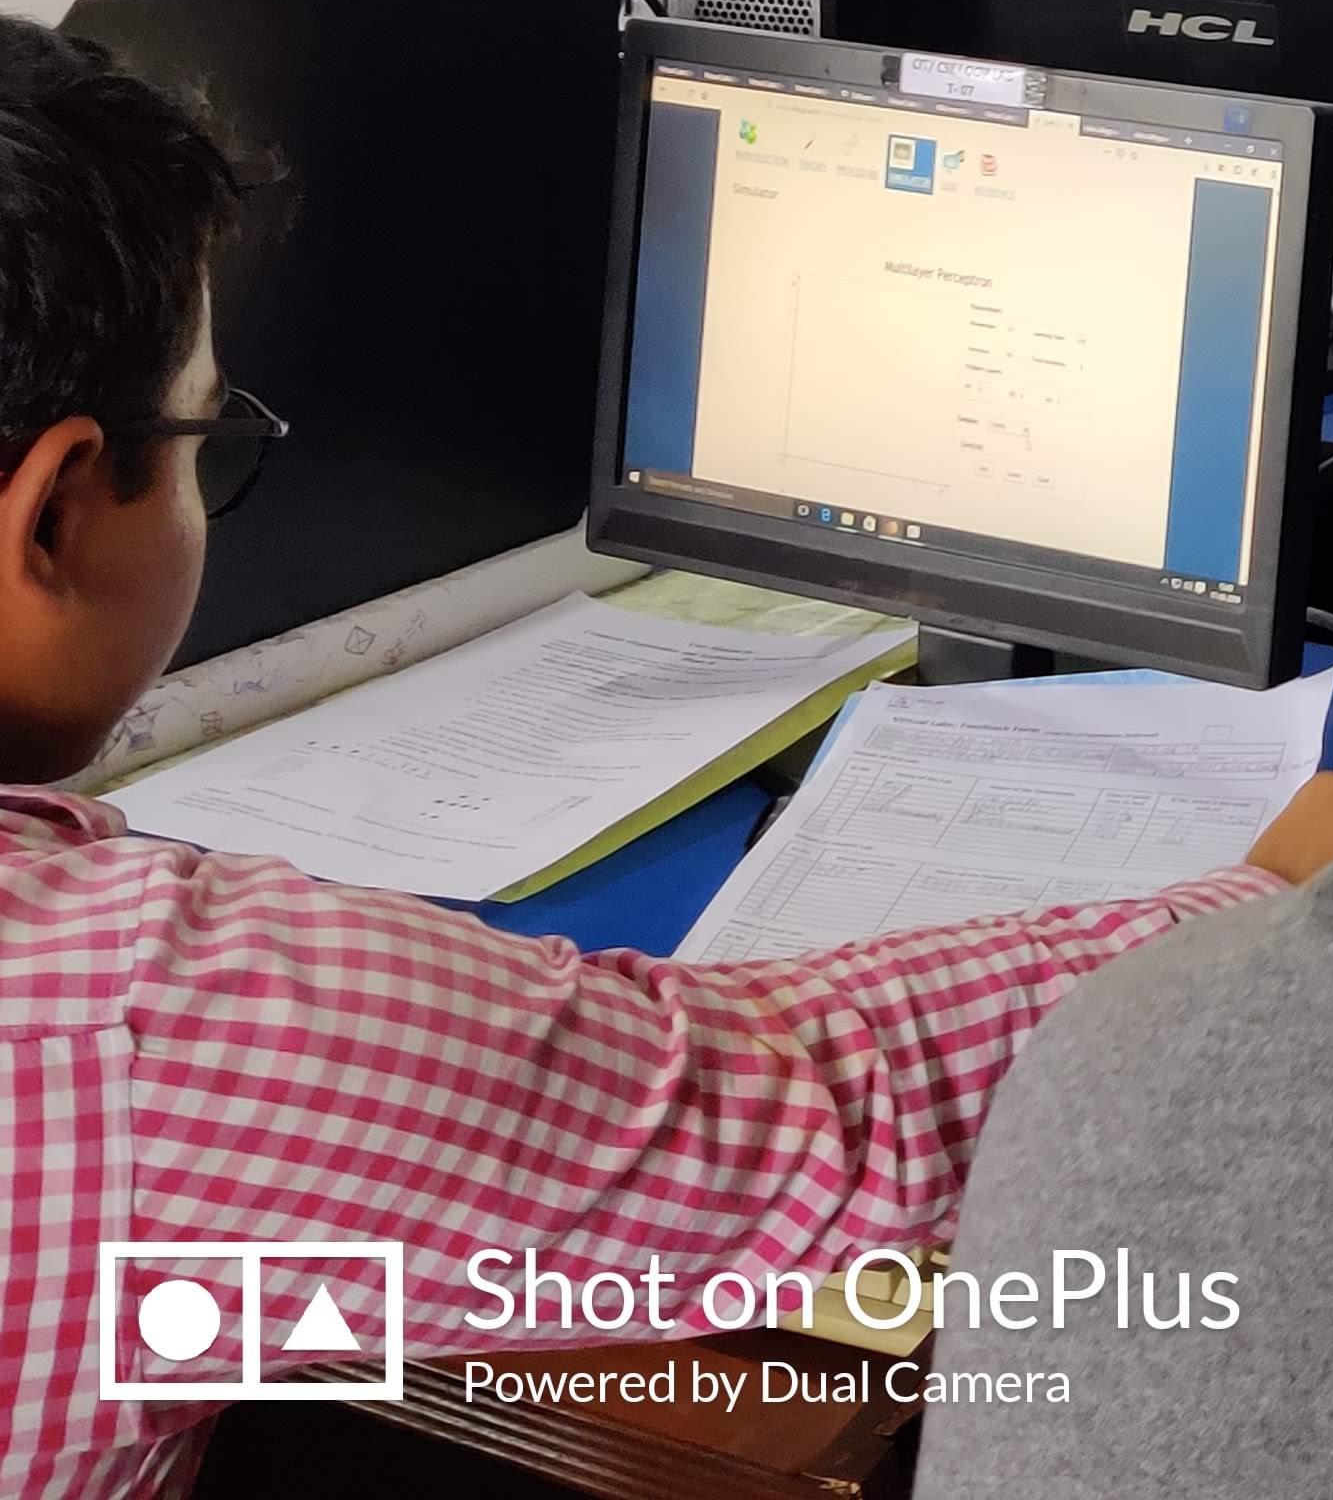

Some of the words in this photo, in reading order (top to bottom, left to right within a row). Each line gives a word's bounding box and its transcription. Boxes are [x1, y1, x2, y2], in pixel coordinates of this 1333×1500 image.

[1127, 9, 1275, 46] HCL
[884, 260, 935, 280] Multilayer
[936, 267, 993, 289] Perceptron
